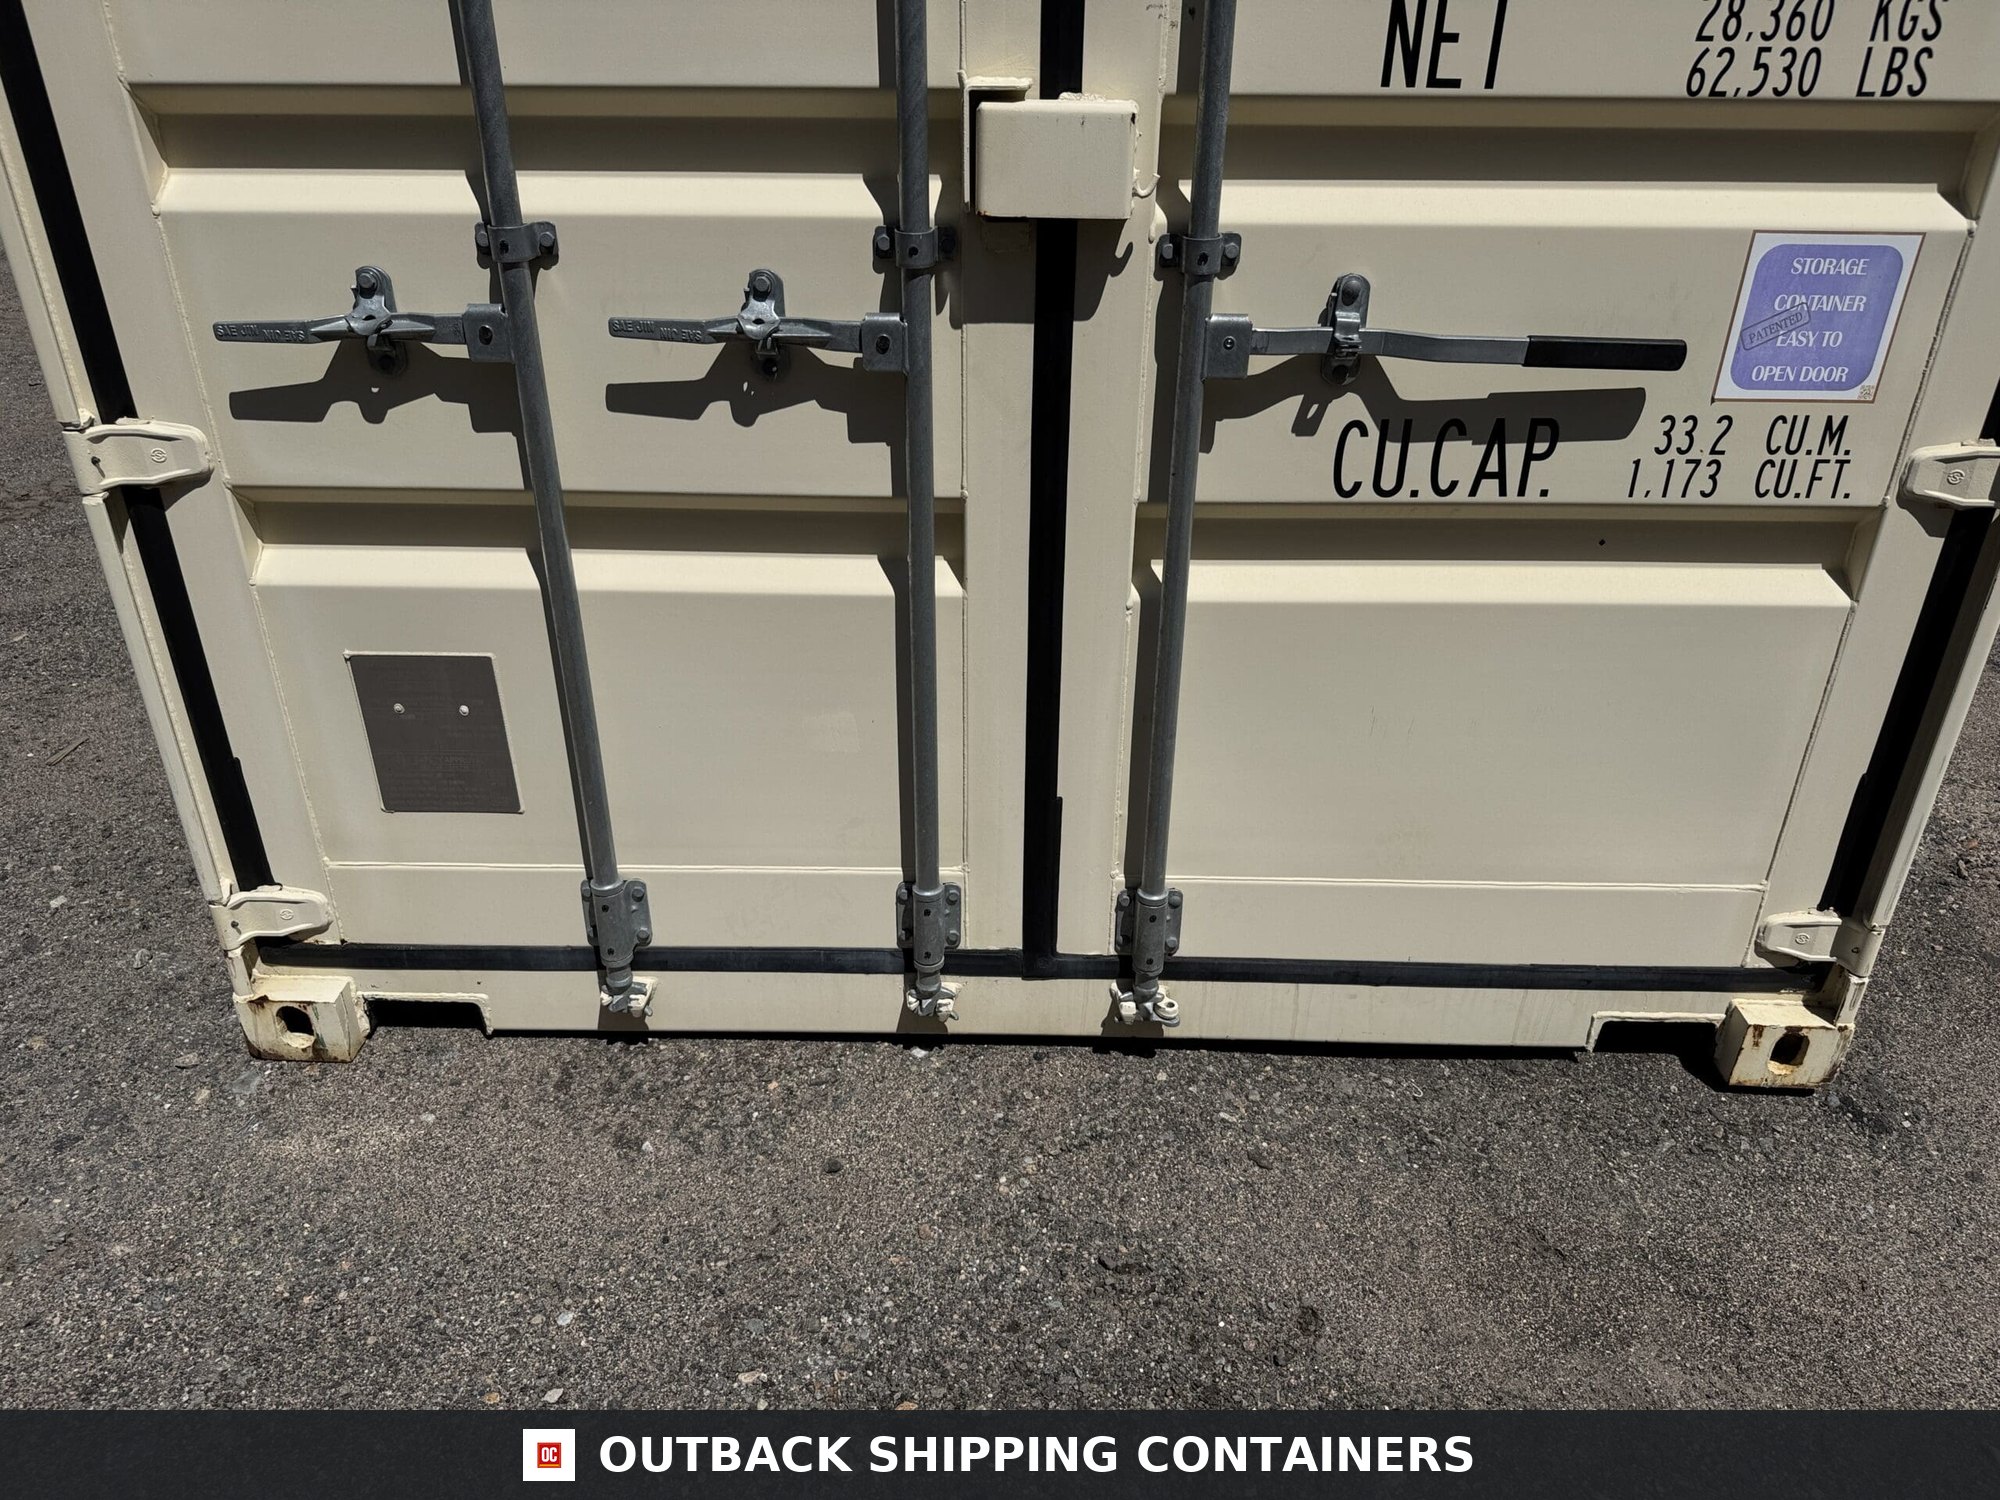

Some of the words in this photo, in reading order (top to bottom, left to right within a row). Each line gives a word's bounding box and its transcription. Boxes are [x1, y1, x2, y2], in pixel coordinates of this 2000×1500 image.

[1695, 0, 1834, 42] 28,360
[1869, 0, 1946, 42] KGS
[1686, 46, 1822, 97] 62,530
[1856, 46, 1934, 97] LBS
[1790, 257, 1870, 275] STORAGE
[1774, 294, 1867, 312] CONTAINER
[1748, 310, 1804, 344] PATENTED
[1776, 330, 1820, 347] EASY
[1822, 330, 1843, 347] TO
[1751, 365, 1797, 381] OPEN
[1799, 366, 1849, 382] DOOR
[1654, 415, 1734, 455] 33.2
[1766, 415, 1851, 456] CU.M.
[1333, 417, 1560, 498] CU.CAP.
[1628, 458, 1722, 498] 1,173
[1754, 459, 1851, 499] CU.FT.
